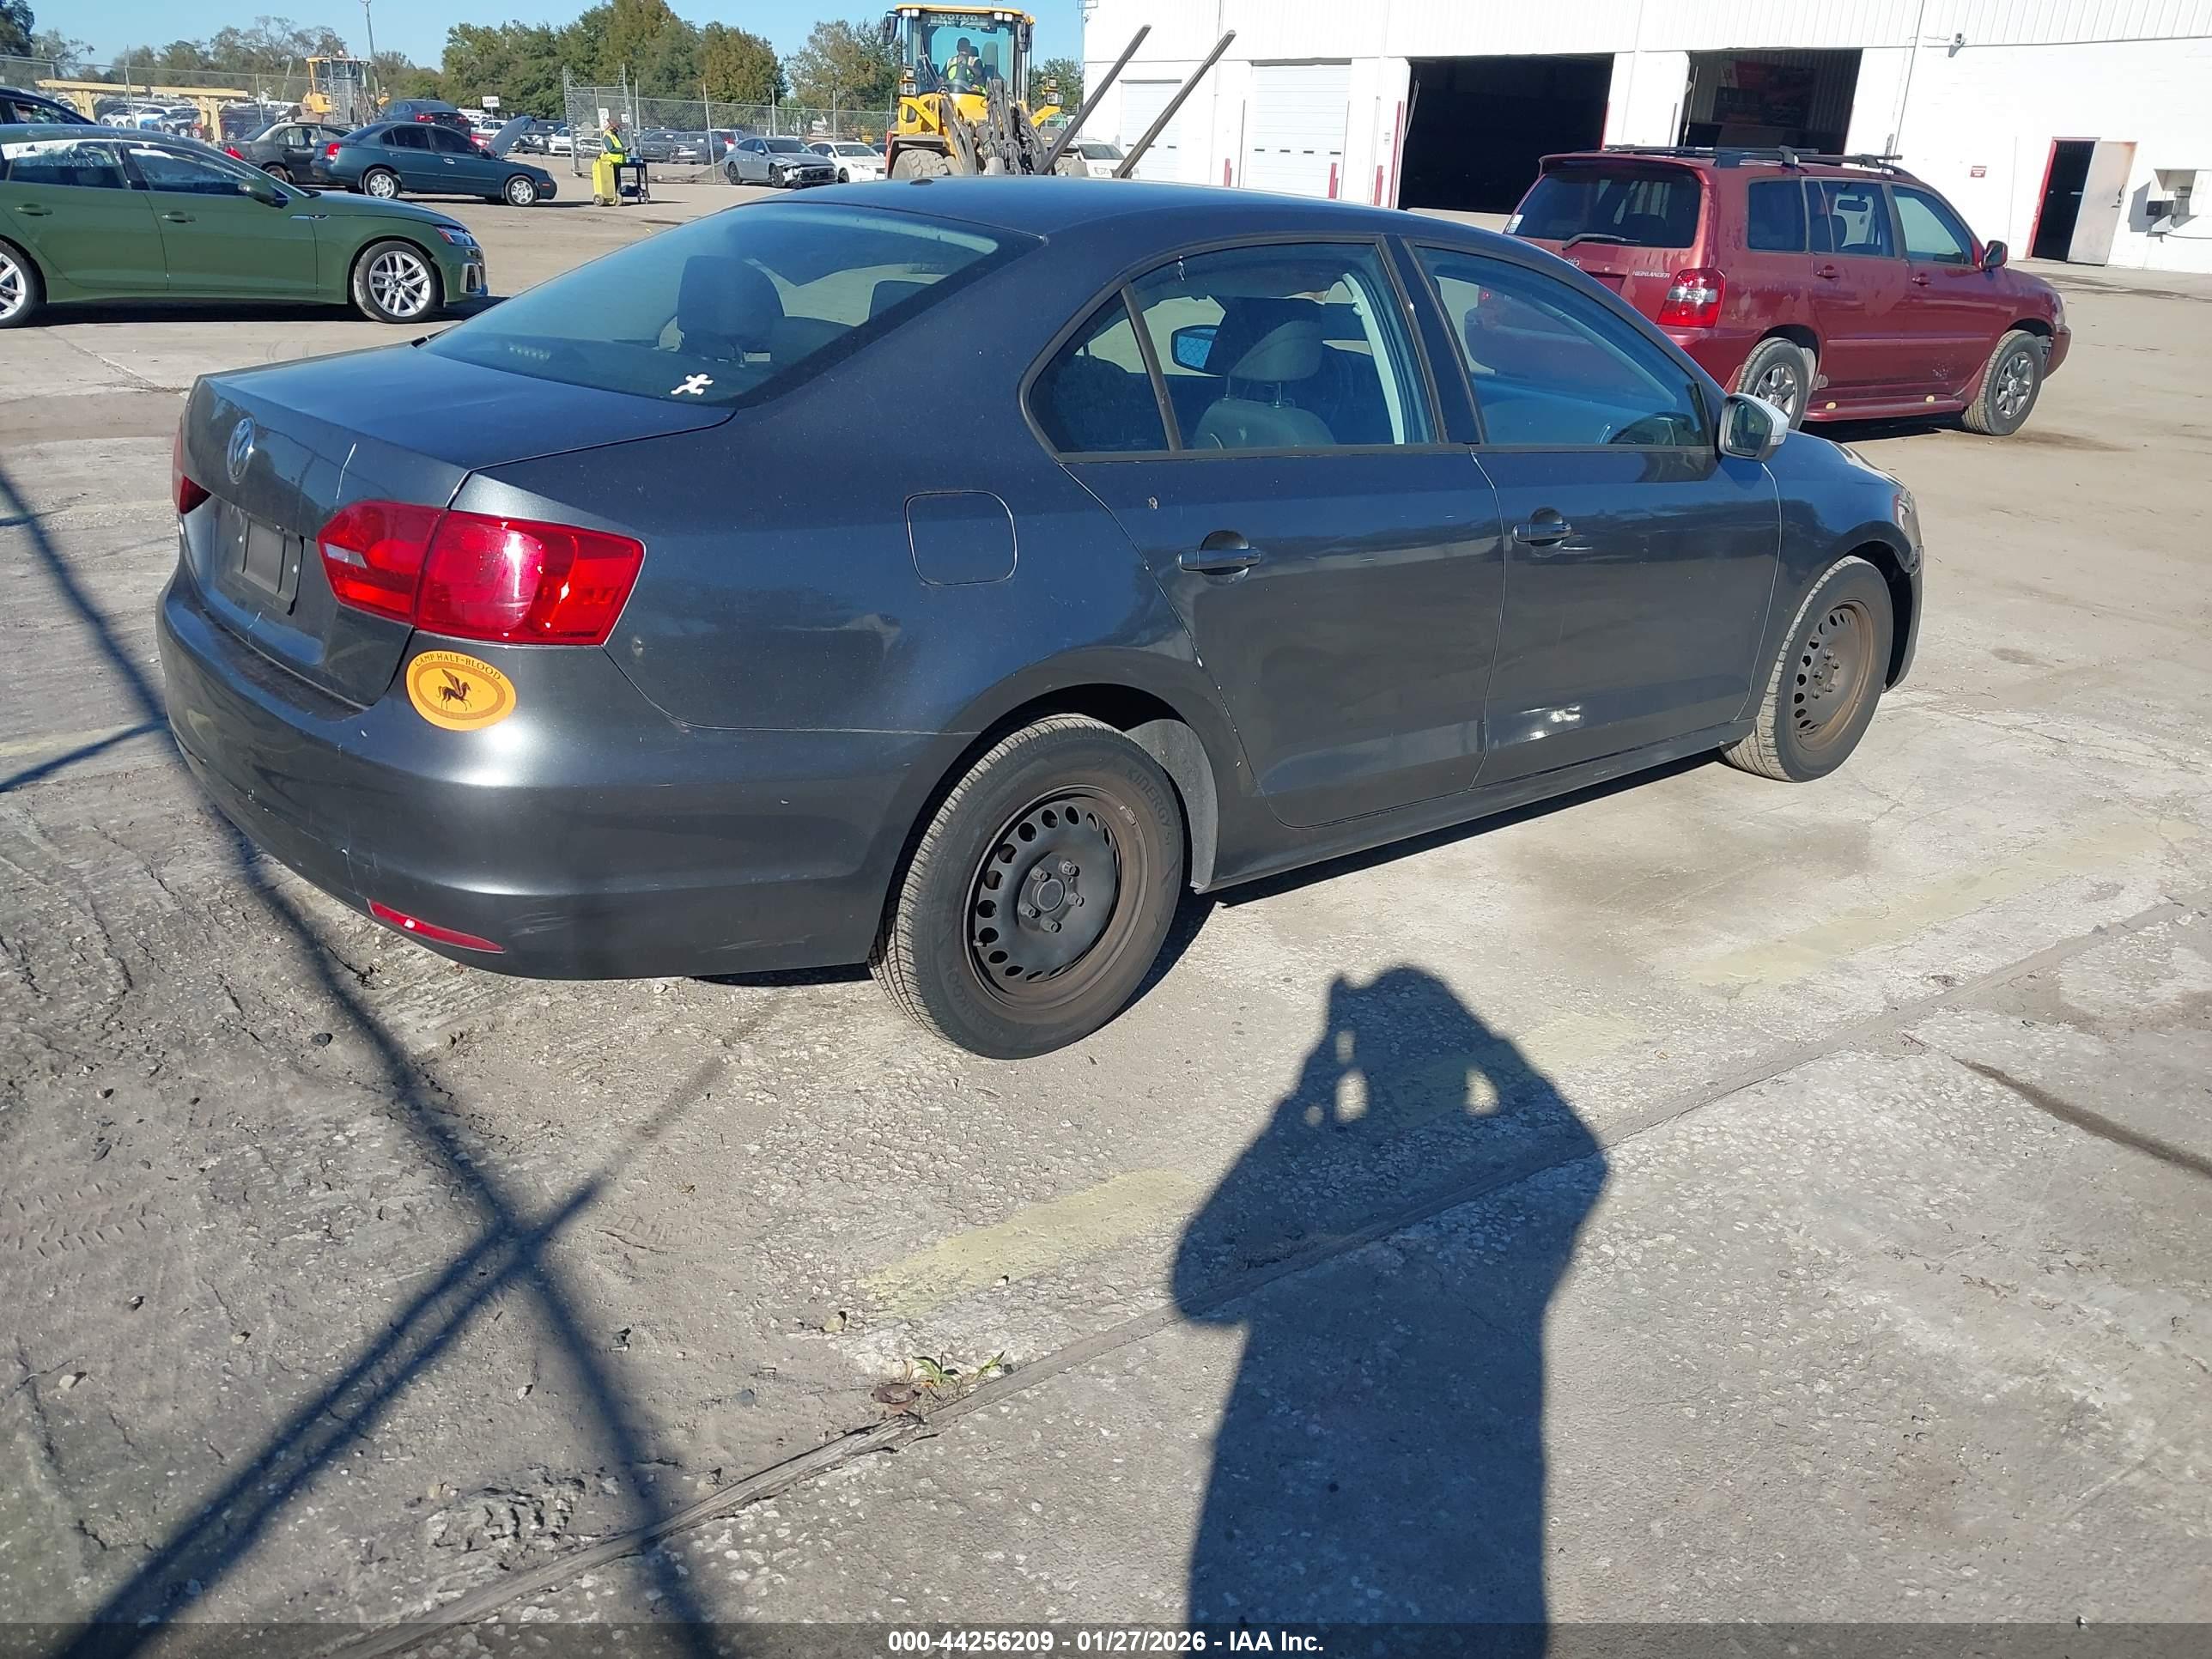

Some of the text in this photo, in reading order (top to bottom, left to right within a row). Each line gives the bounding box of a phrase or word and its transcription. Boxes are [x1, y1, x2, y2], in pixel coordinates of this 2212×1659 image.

[939, 13, 978, 21] VOLVO
[1632, 270, 1671, 278] HIGHLANDER
[414, 653, 501, 680] CAMP HALF-BLOOD
